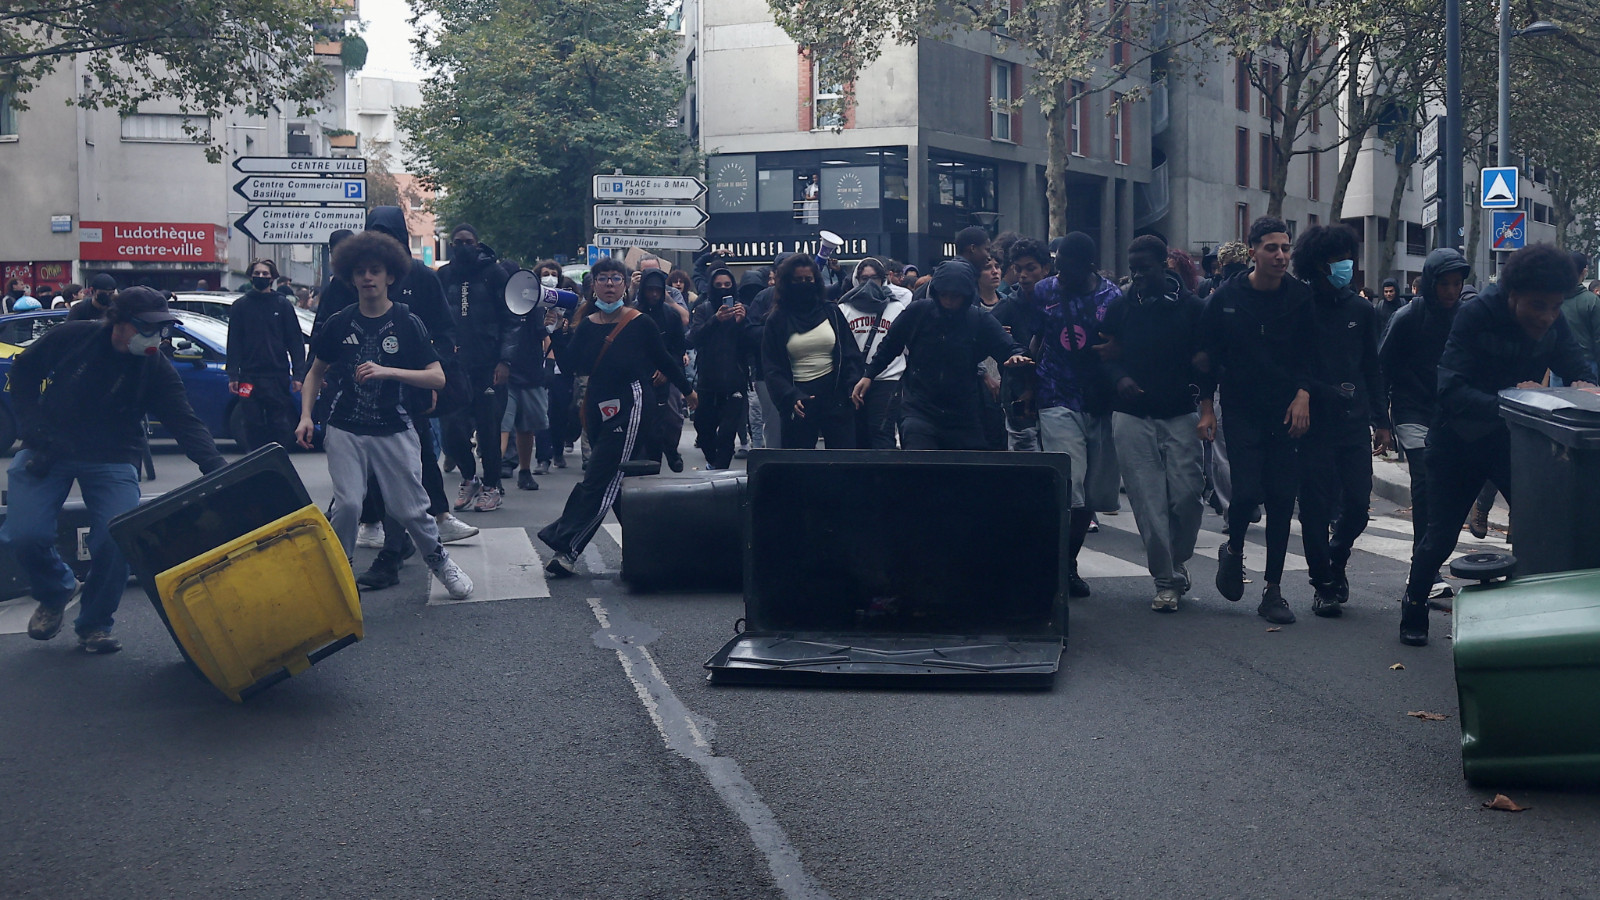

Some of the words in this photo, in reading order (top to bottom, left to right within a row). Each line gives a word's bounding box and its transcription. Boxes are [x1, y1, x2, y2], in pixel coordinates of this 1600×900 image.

[291, 162, 330, 170] CENTRE
[336, 162, 363, 170] VILLE
[253, 180, 284, 188] Centre
[288, 180, 342, 190] Commercial
[625, 180, 650, 188] PLACE
[253, 190, 296, 198] Basilique
[347, 184, 359, 197] P
[263, 210, 310, 219] Cimetière
[314, 210, 364, 220] Communal
[263, 221, 295, 229] Caisse
[300, 221, 363, 230] d'Allocations
[615, 218, 667, 226] Technologie
[114, 226, 206, 243] Ludothèque
[263, 231, 314, 239] Familiales
[614, 237, 658, 247] République
[118, 243, 202, 256] centre-ville
